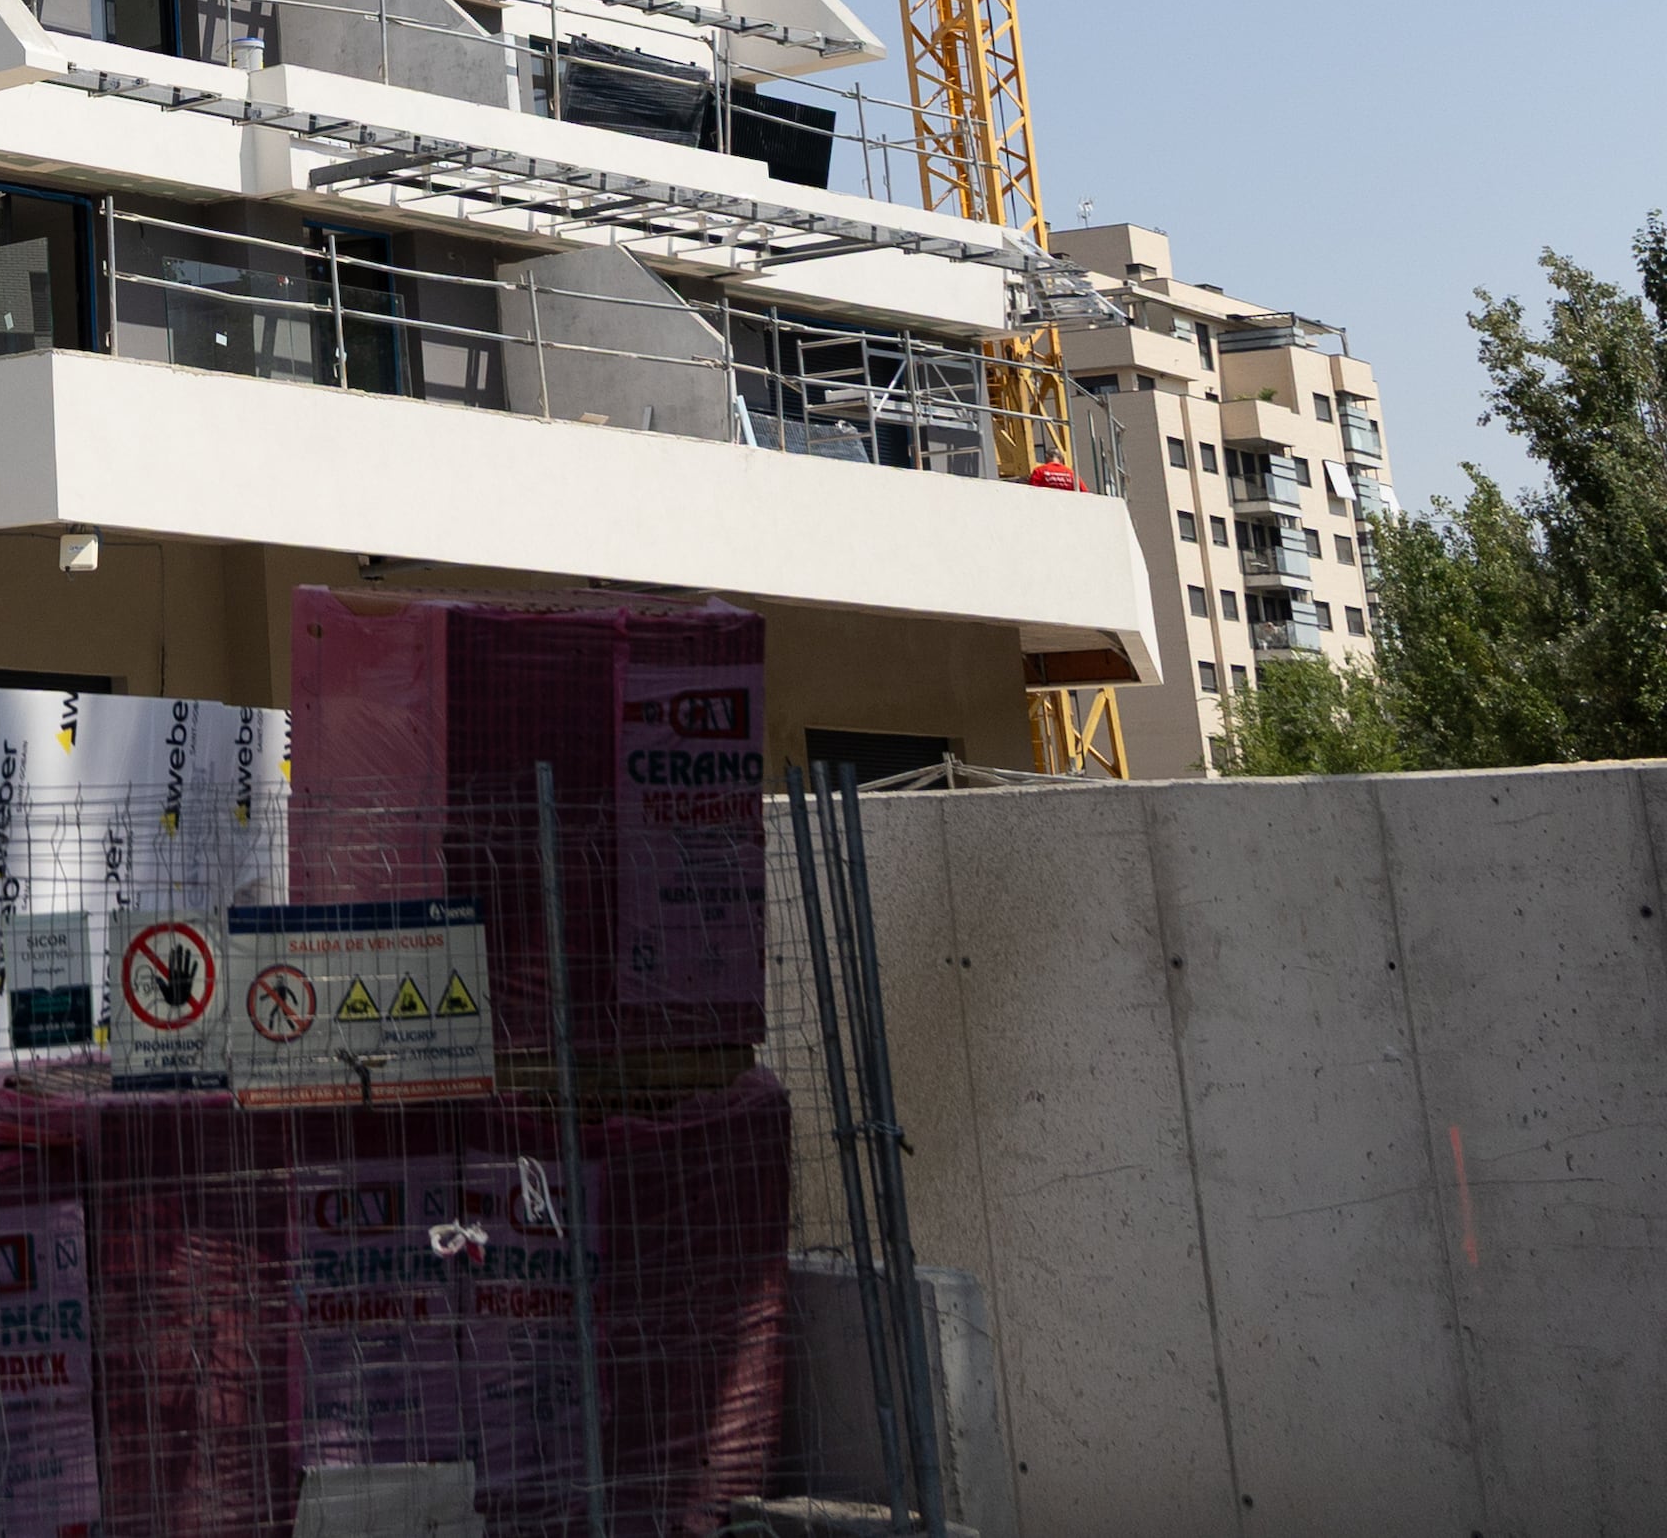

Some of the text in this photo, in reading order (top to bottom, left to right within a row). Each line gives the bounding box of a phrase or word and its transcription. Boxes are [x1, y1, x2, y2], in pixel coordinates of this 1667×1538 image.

[288, 933, 445, 953] SALIDA DE VEHCULOS
[134, 1039, 205, 1053] PROHIBIDO
